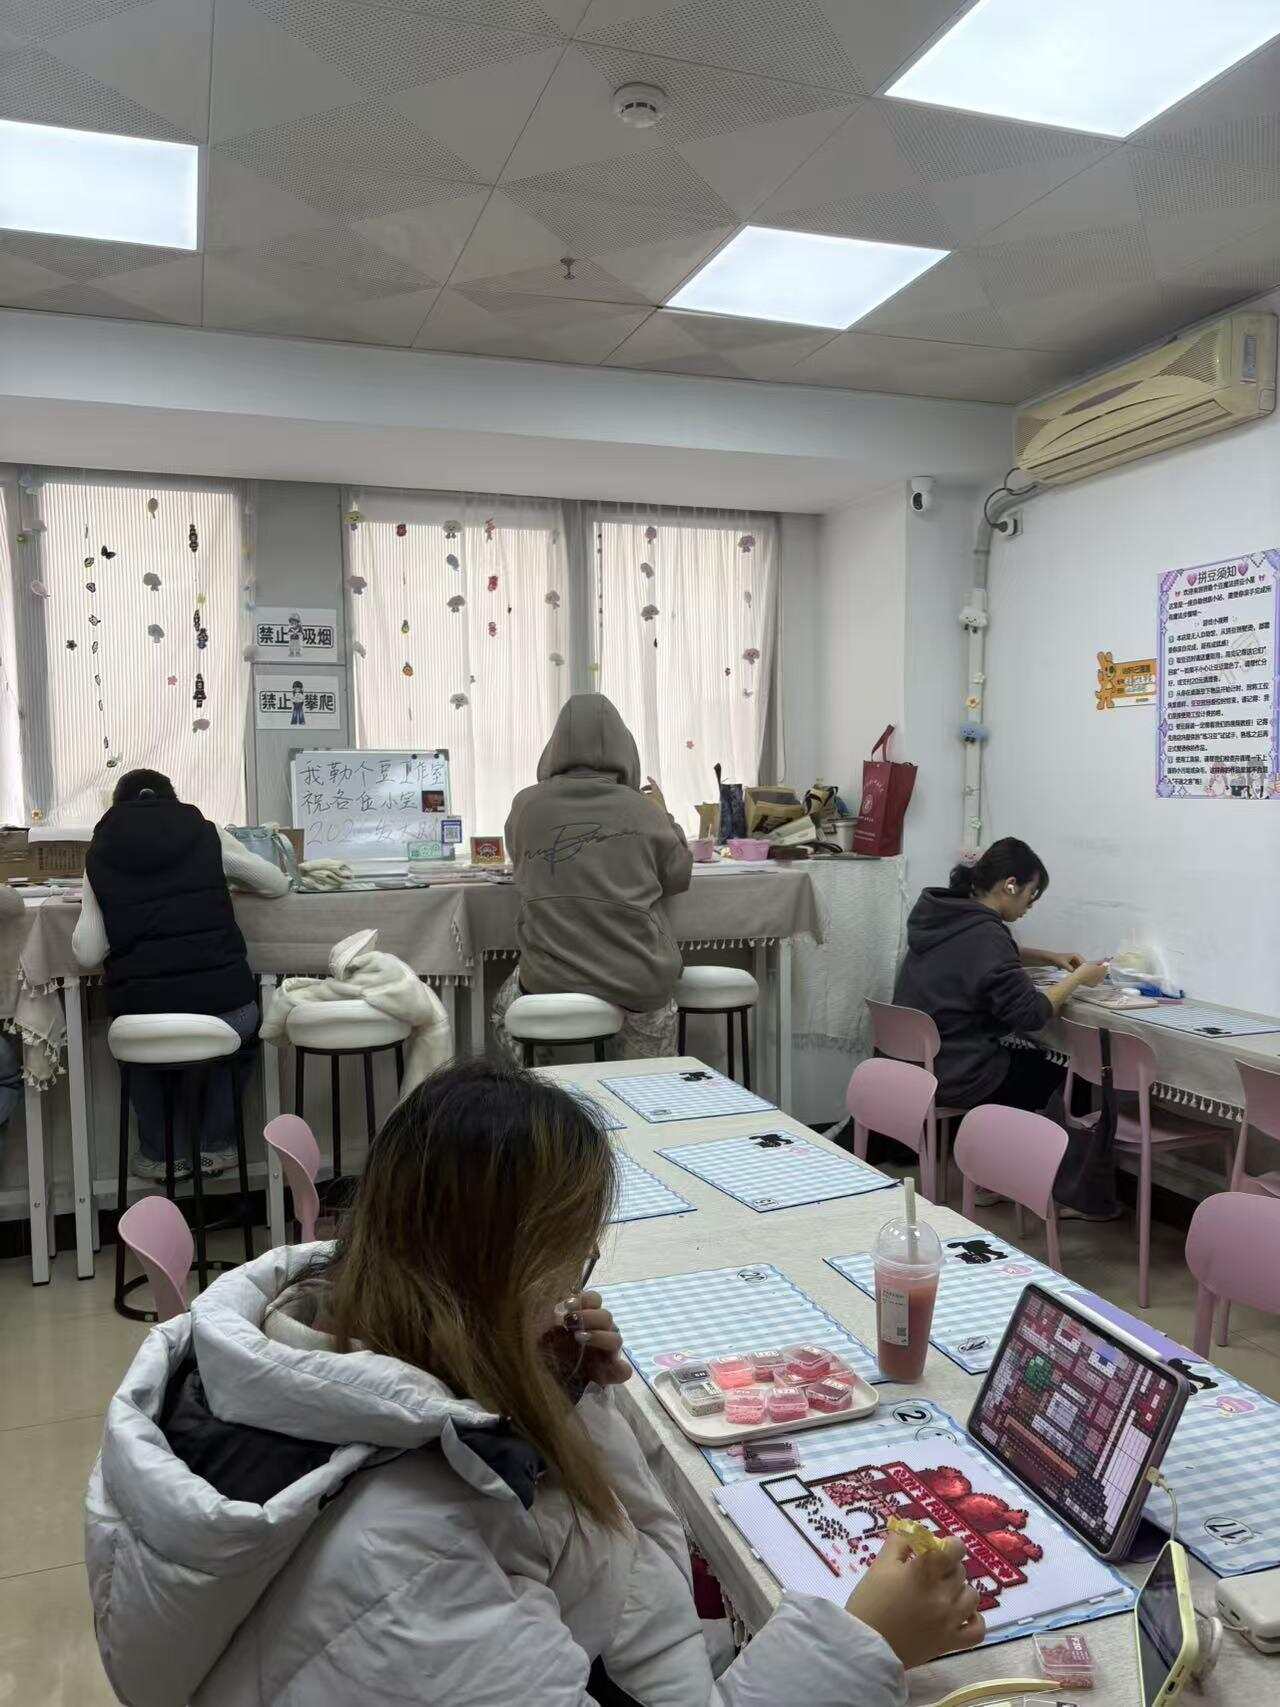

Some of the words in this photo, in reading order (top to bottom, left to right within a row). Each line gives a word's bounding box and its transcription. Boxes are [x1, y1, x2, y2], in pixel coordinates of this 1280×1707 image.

[1198, 564, 1237, 584] 拼豆须知
[259, 626, 332, 646] 禁止吸烟
[262, 693, 334, 711] 禁止攀爬
[299, 760, 446, 787] 我勒个豆工作室
[896, 1411, 927, 1423] 2
[926, 1501, 967, 1533] FRUIT
[963, 1534, 1008, 1571] STORE
[1206, 1522, 1248, 1540] 17
